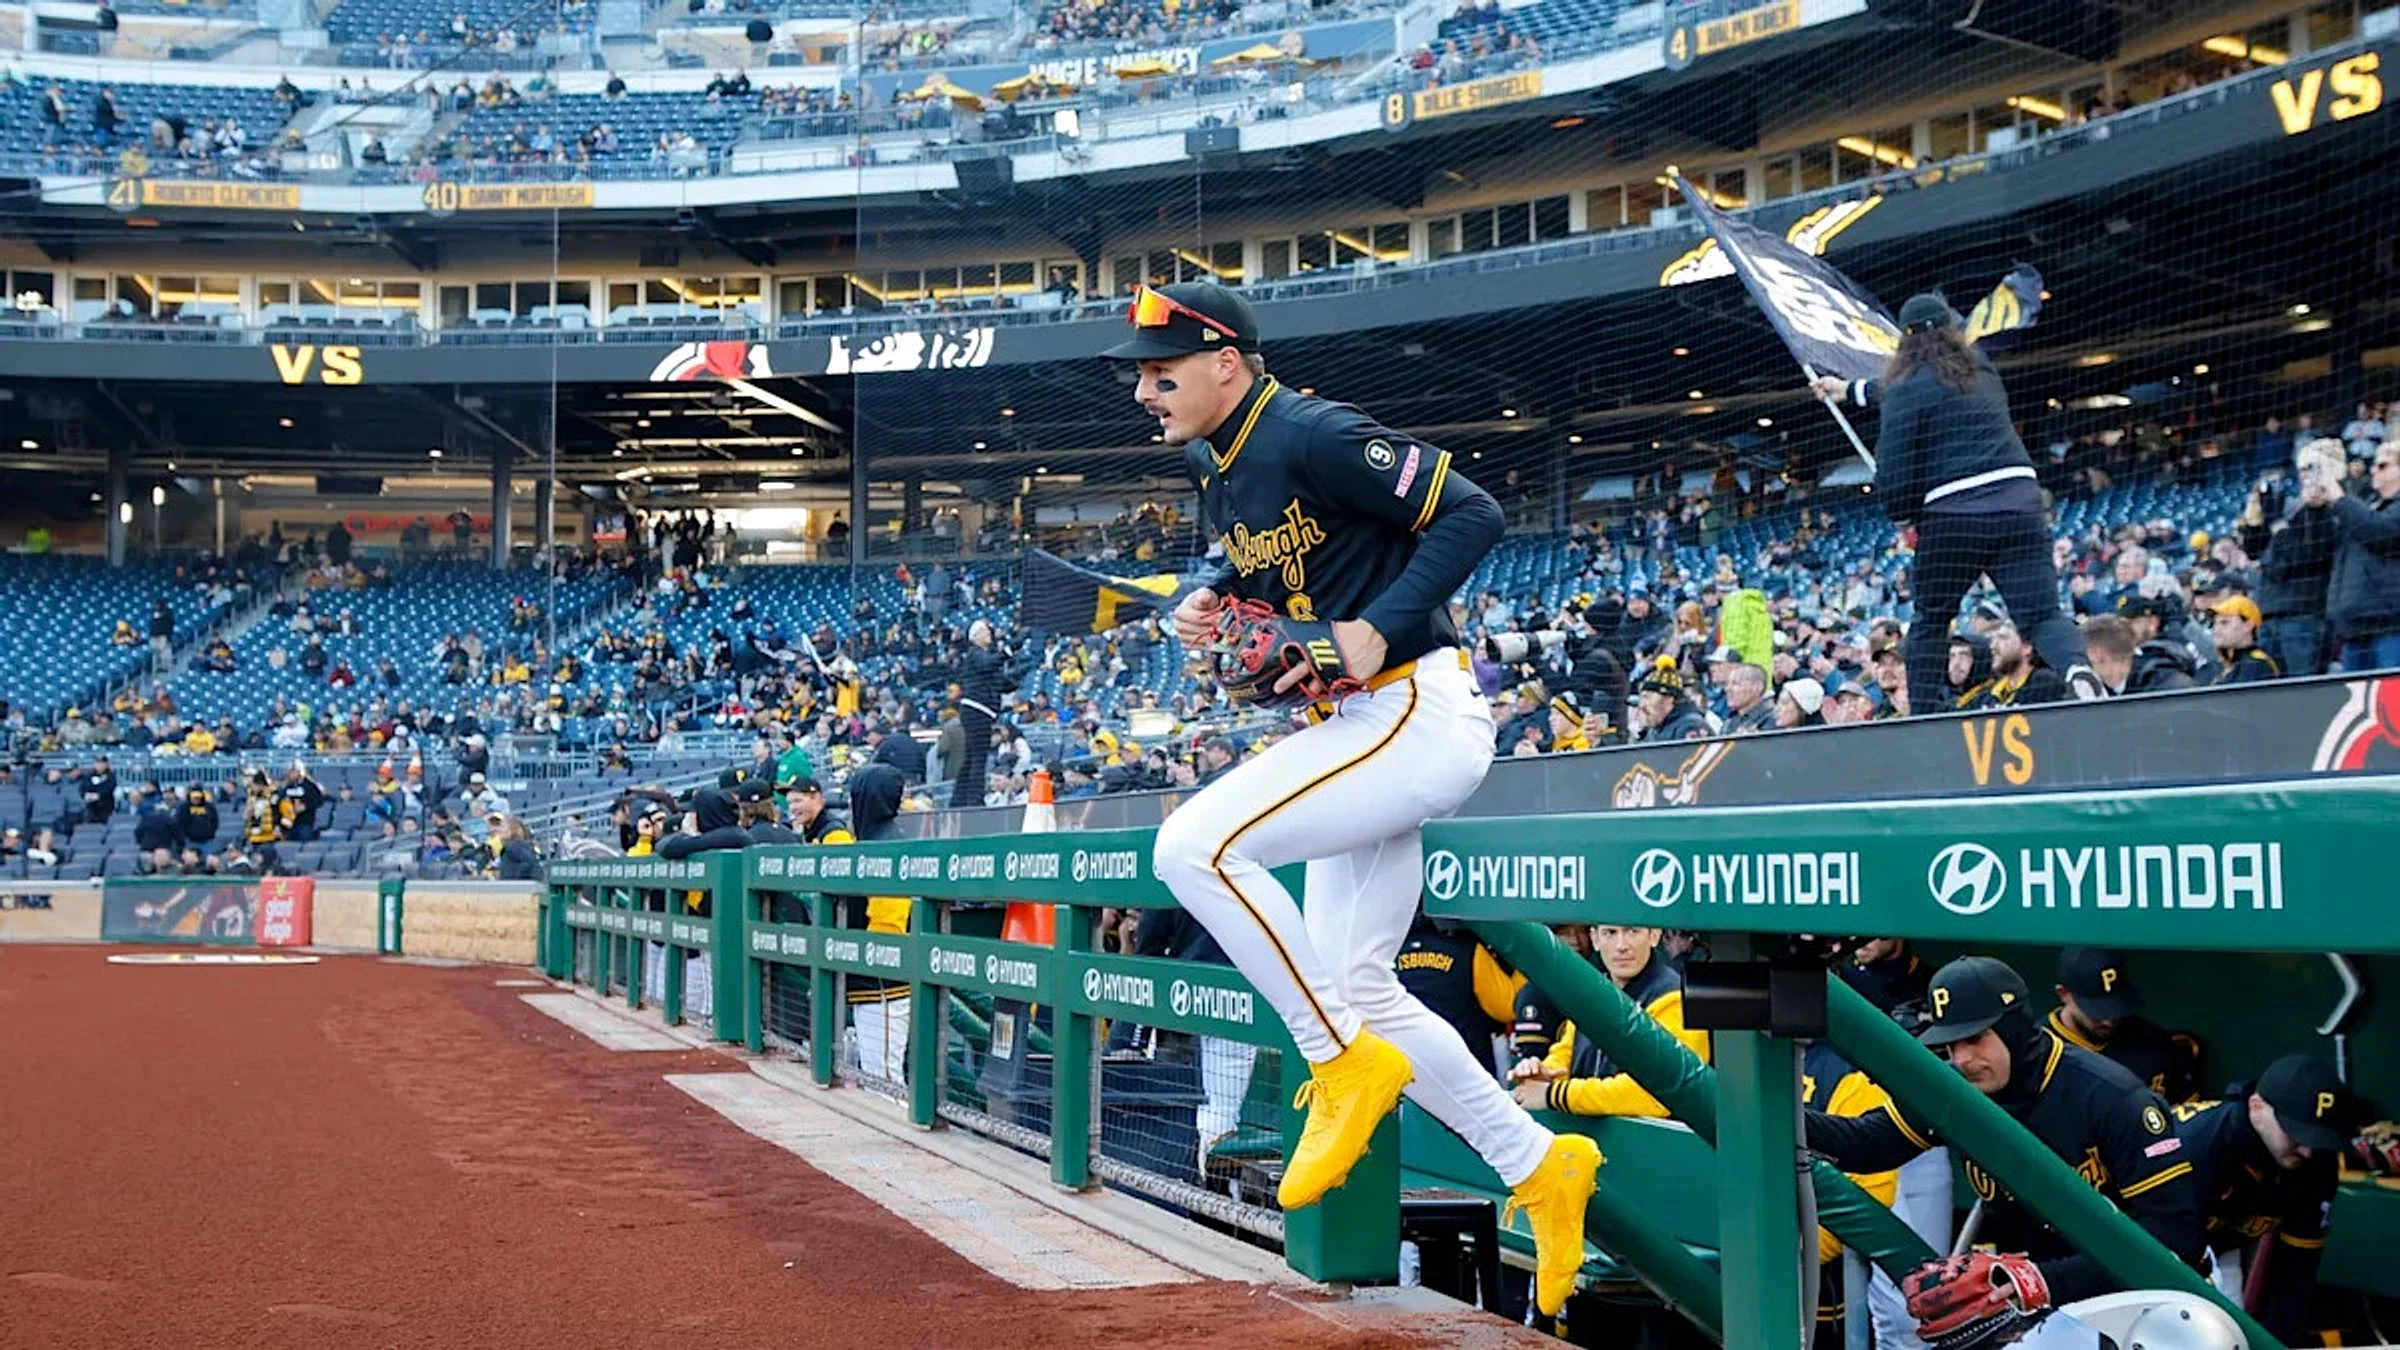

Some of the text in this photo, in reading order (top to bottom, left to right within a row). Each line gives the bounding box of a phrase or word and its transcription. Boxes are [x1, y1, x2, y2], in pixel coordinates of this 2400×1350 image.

[1671, 27, 1688, 61] 4
[1387, 93, 1404, 124] 8
[2271, 51, 2383, 135] VS
[424, 182, 458, 211] 40
[271, 344, 362, 385] VS
[1370, 445, 1391, 463] 9
[1962, 713, 2034, 786] VS
[960, 855, 995, 878] HYUNDAI
[1020, 853, 1060, 880] HYUNDAI
[1089, 851, 1137, 880] HYUNDAI
[1468, 842, 2284, 909] HYUNDAI HYUNDAI HYUNDAI
[941, 950, 1037, 988] HYUNDAI HYUNDAI
[2102, 968, 2117, 992] P
[1102, 972, 1253, 1025] HYUNDAI HYUNDAI
[1933, 987, 1950, 1018] P
[2148, 1111, 2160, 1129] 9
[2316, 1092, 2334, 1118] P
